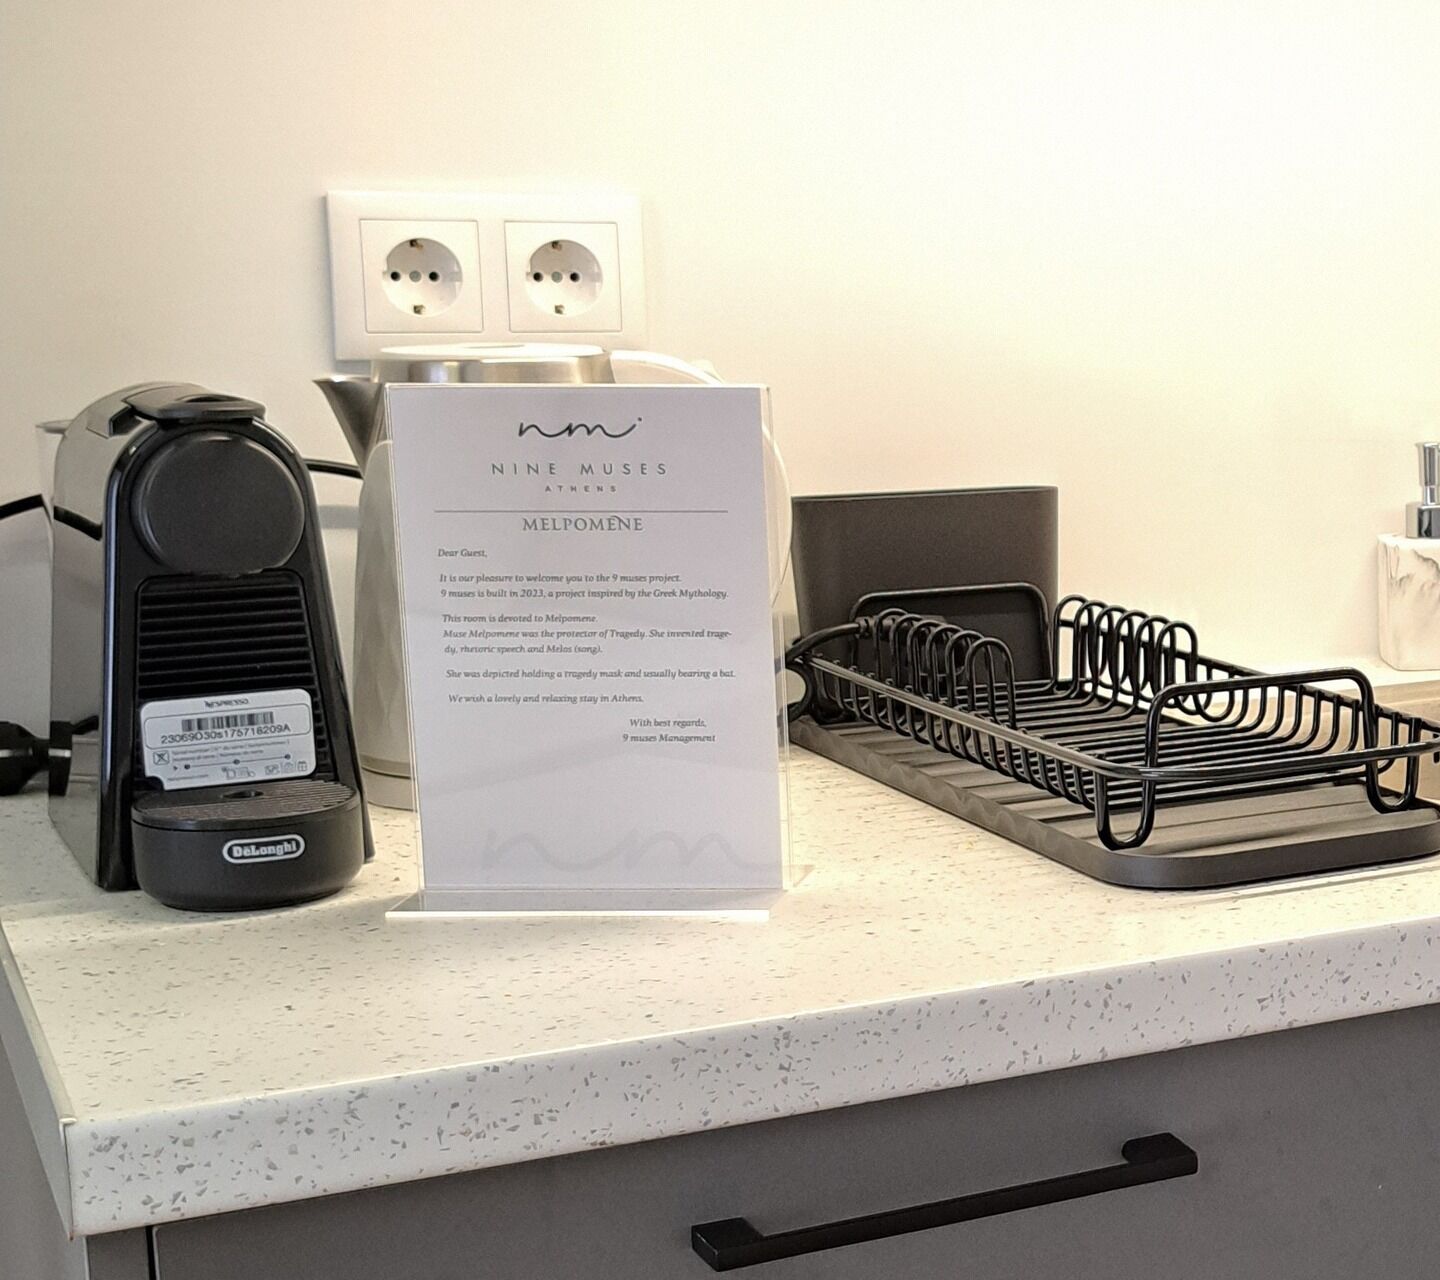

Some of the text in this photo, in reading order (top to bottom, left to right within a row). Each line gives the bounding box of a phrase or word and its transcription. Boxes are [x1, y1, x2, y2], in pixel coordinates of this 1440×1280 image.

[491, 463, 667, 475] NINE MUSES
[545, 485, 617, 493] ATHENS
[476, 573, 513, 584] pleasure
[526, 573, 565, 582] welcome
[566, 575, 582, 584] you
[596, 573, 610, 582] the
[648, 574, 682, 584] project.
[448, 590, 476, 598] muses
[486, 588, 507, 598] built
[520, 589, 546, 599] 2023,
[555, 589, 586, 599] project
[587, 588, 623, 599] inspired
[638, 588, 652, 598] the
[653, 588, 677, 598] Greek
[679, 588, 729, 600] Mythology.
[442, 614, 461, 623] This
[498, 614, 532, 623] devoted
[545, 613, 598, 624] Melpomene.
